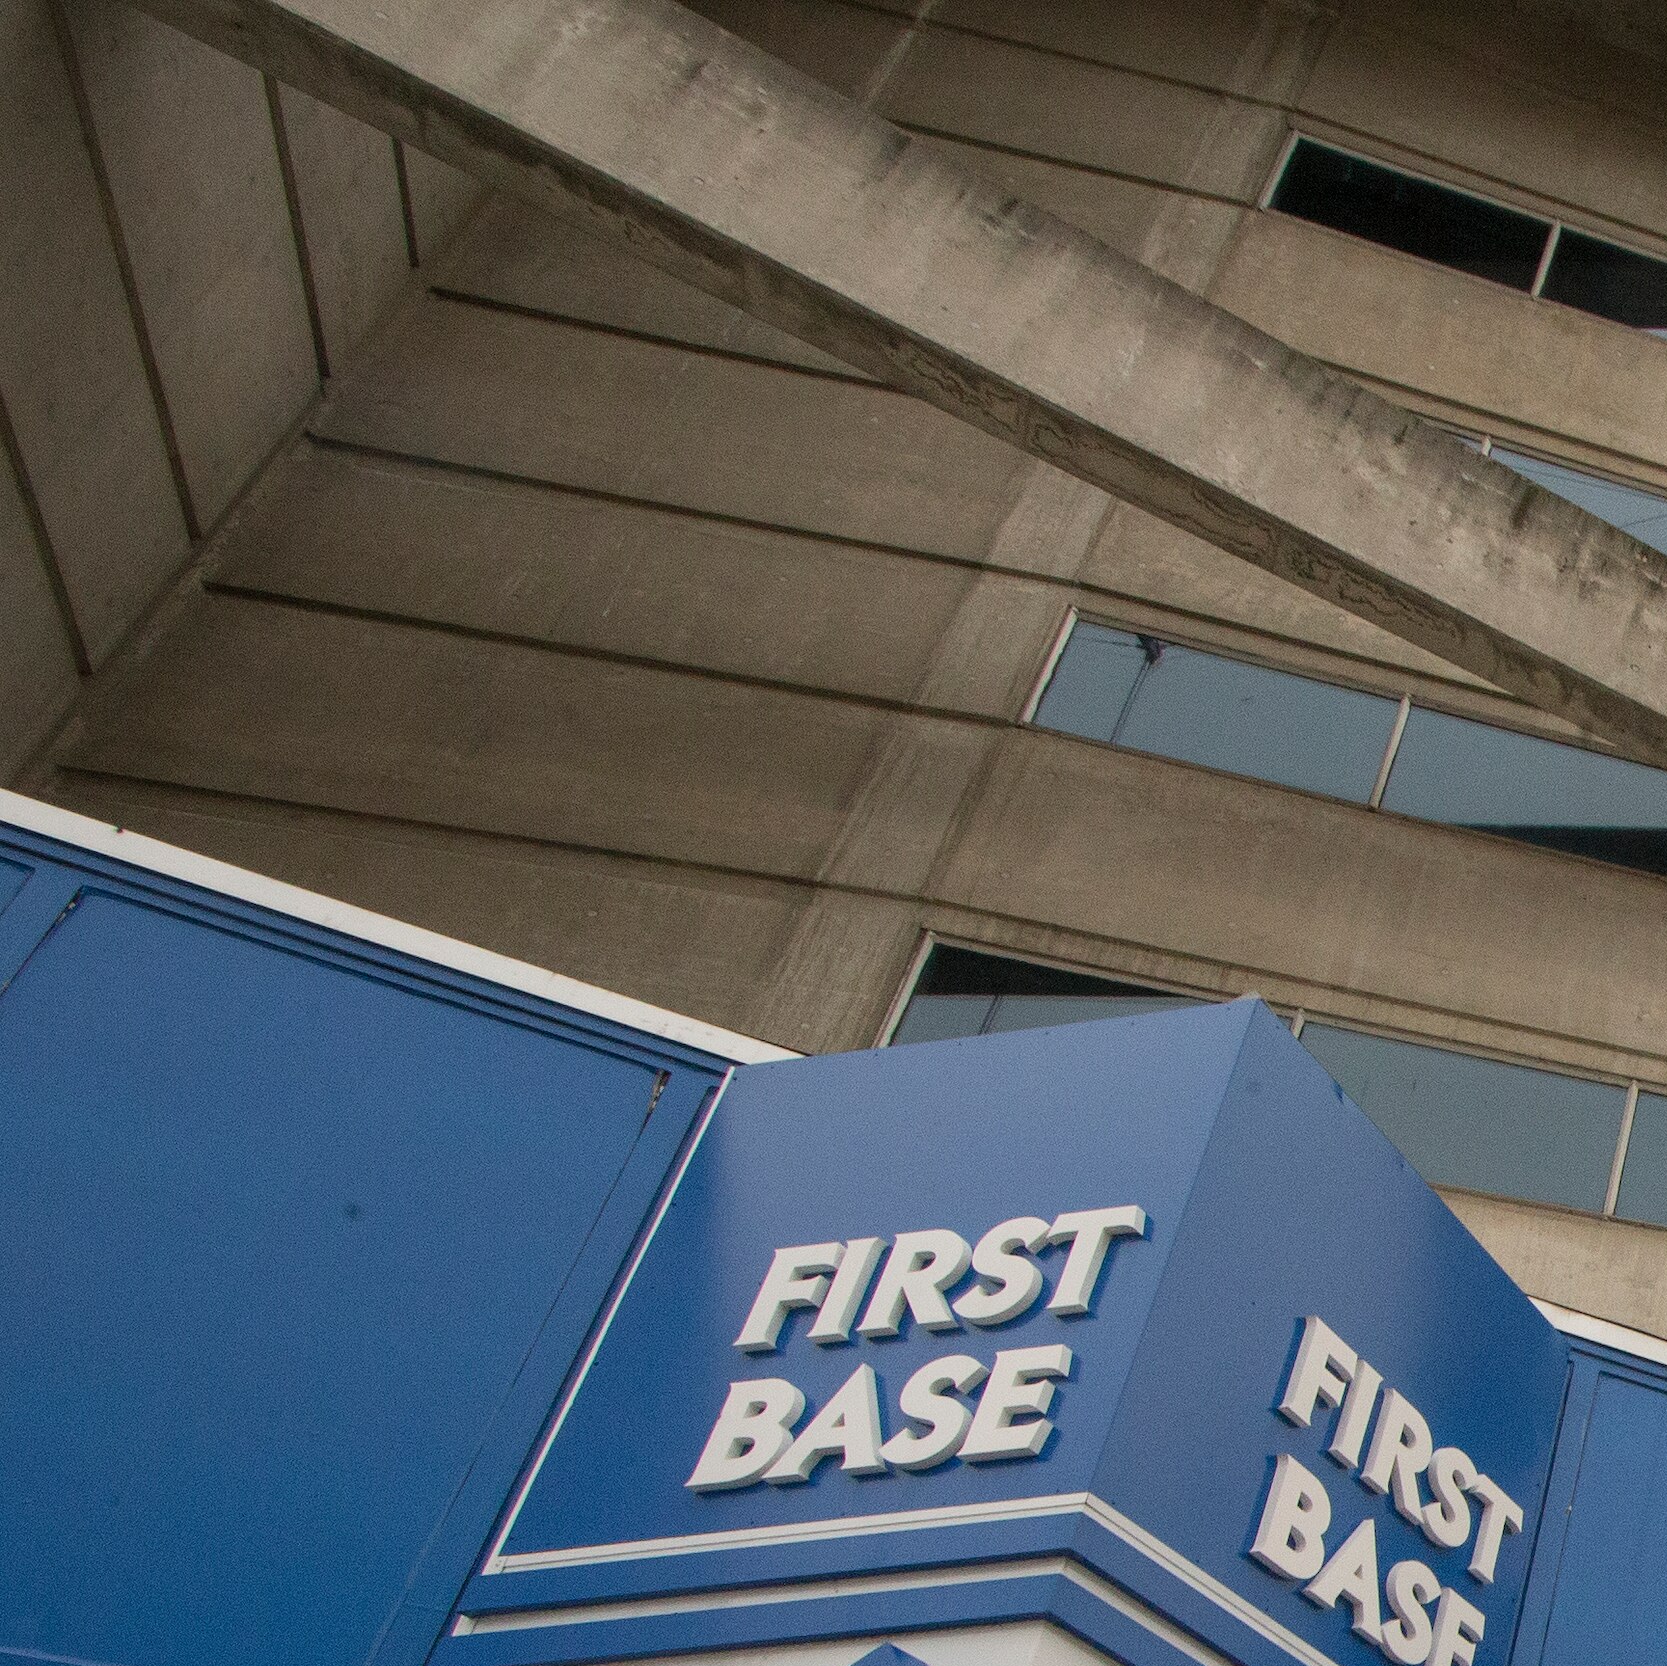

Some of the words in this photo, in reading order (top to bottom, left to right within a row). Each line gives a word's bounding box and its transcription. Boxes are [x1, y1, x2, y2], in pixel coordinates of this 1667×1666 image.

[734, 1203, 1146, 1353] FIRST
[684, 1343, 1074, 1493] BASE
[1278, 1315, 1524, 1584] FIRST
